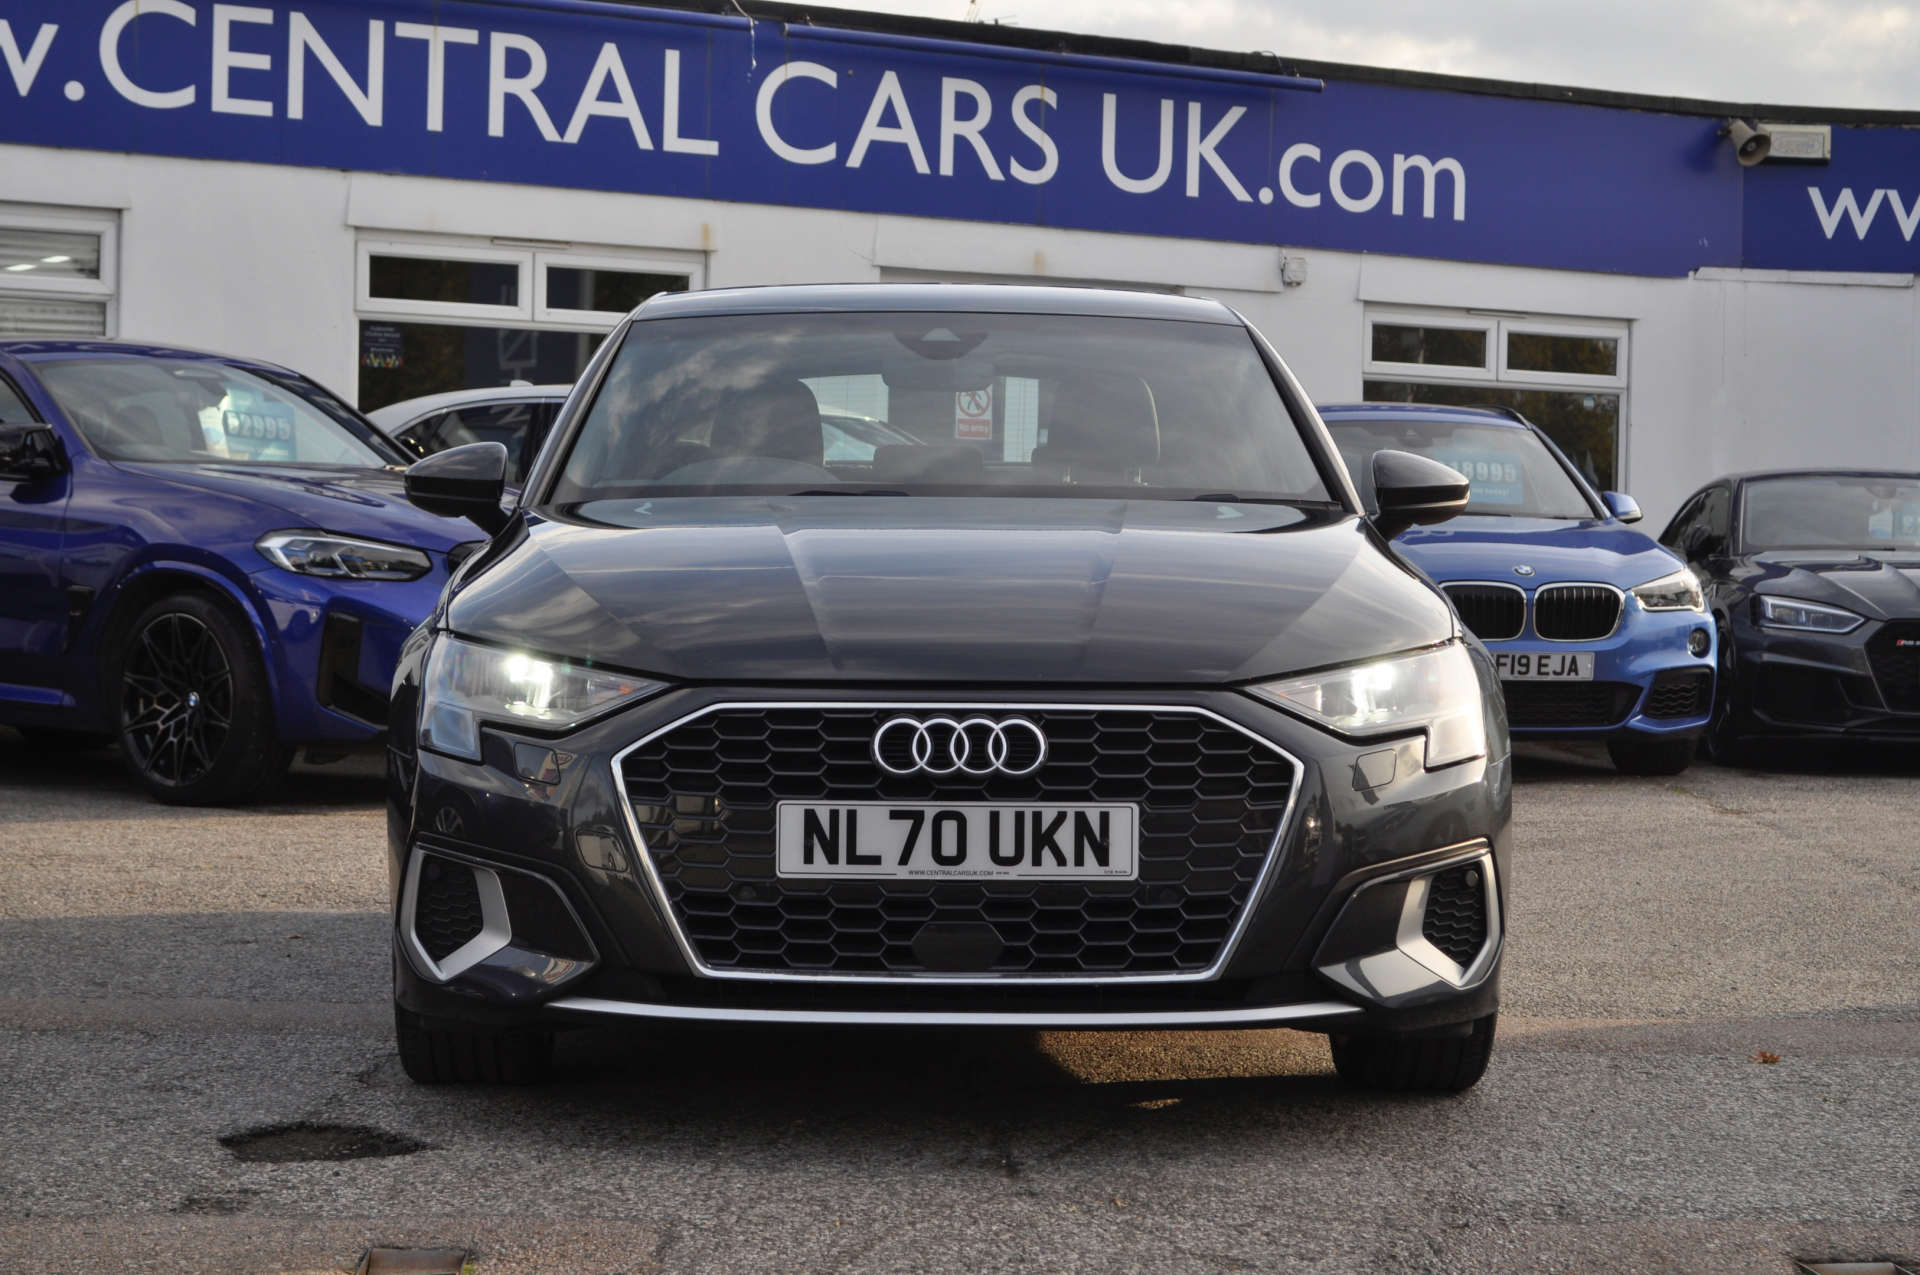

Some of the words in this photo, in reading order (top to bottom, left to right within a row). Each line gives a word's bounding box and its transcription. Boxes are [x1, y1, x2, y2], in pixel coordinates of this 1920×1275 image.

[756, 61, 1059, 185] CARS
[1102, 92, 1466, 221] UK.com
[1537, 655, 1580, 676] EJA
[803, 808, 968, 866] NL70
[989, 810, 1110, 867] UKN
